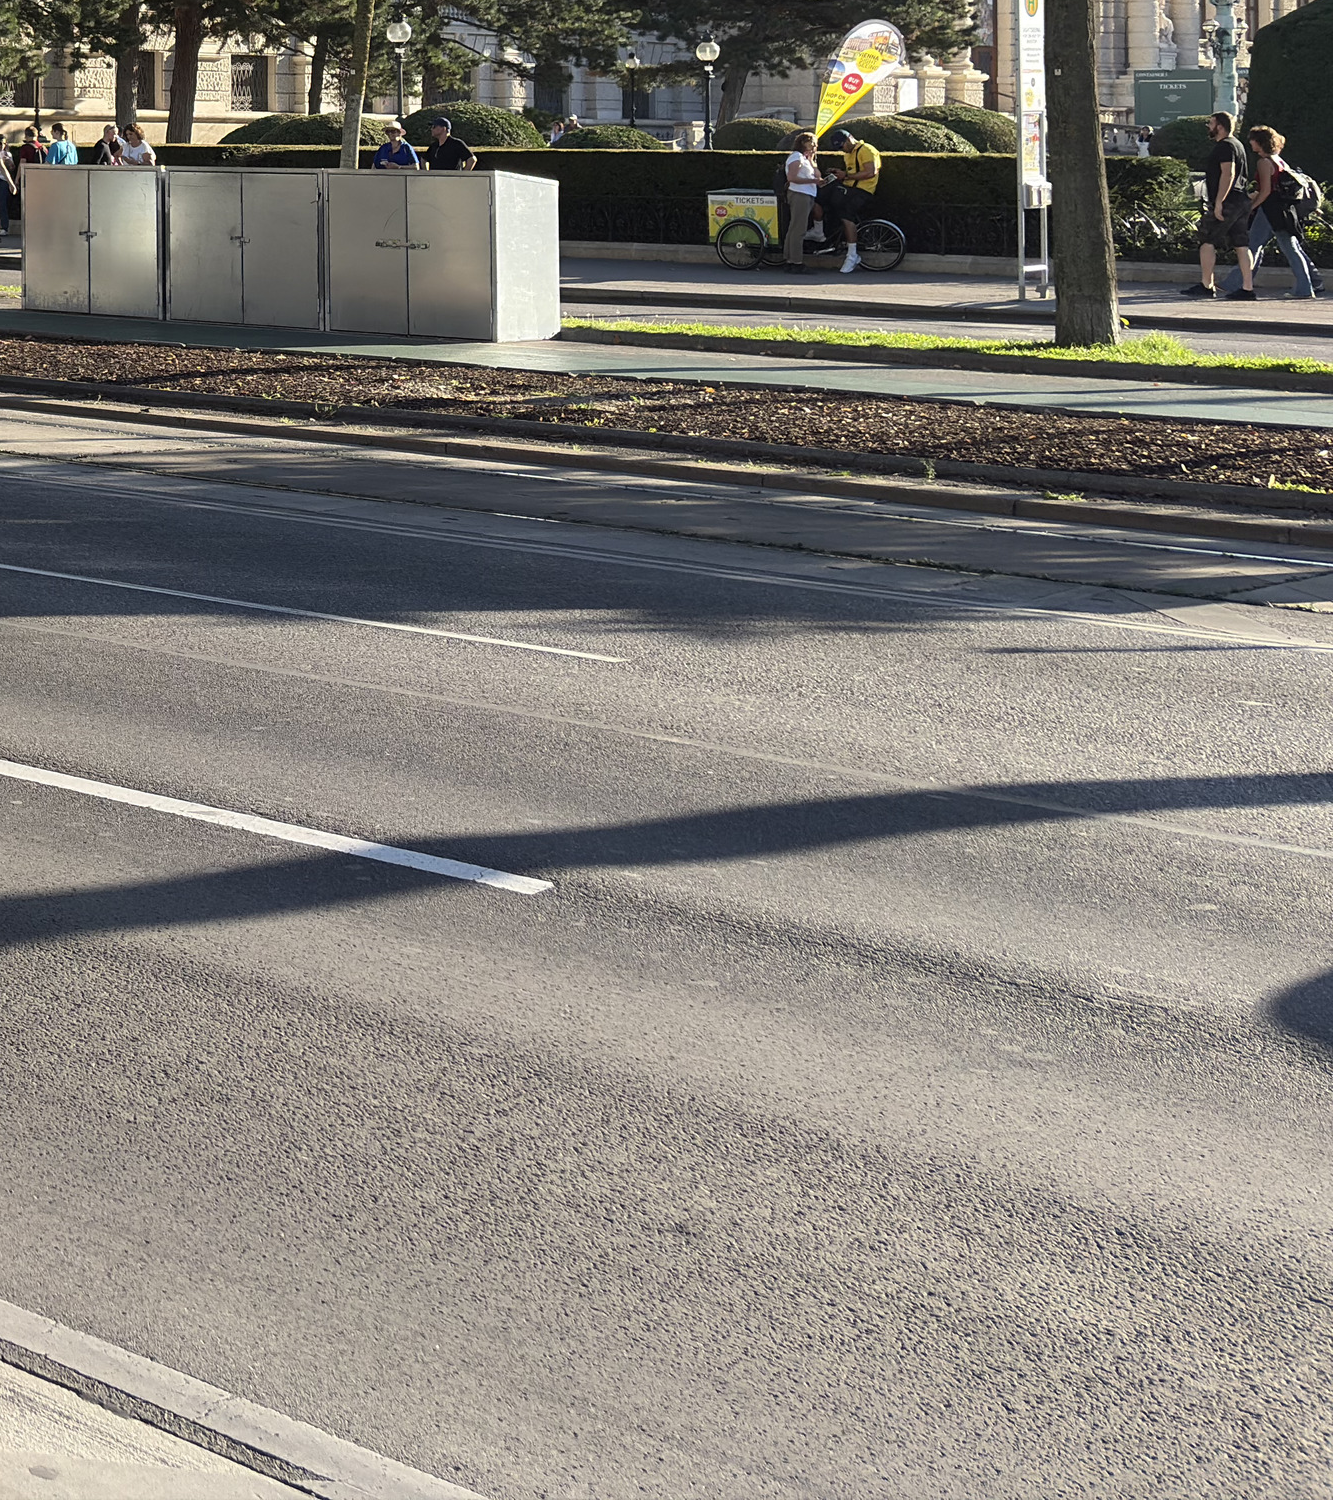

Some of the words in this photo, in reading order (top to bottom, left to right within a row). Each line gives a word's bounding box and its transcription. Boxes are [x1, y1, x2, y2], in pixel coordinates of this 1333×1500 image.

[847, 76, 860, 85] BUY
[844, 83, 857, 91] NOW
[735, 197, 764, 205] TICKETS
